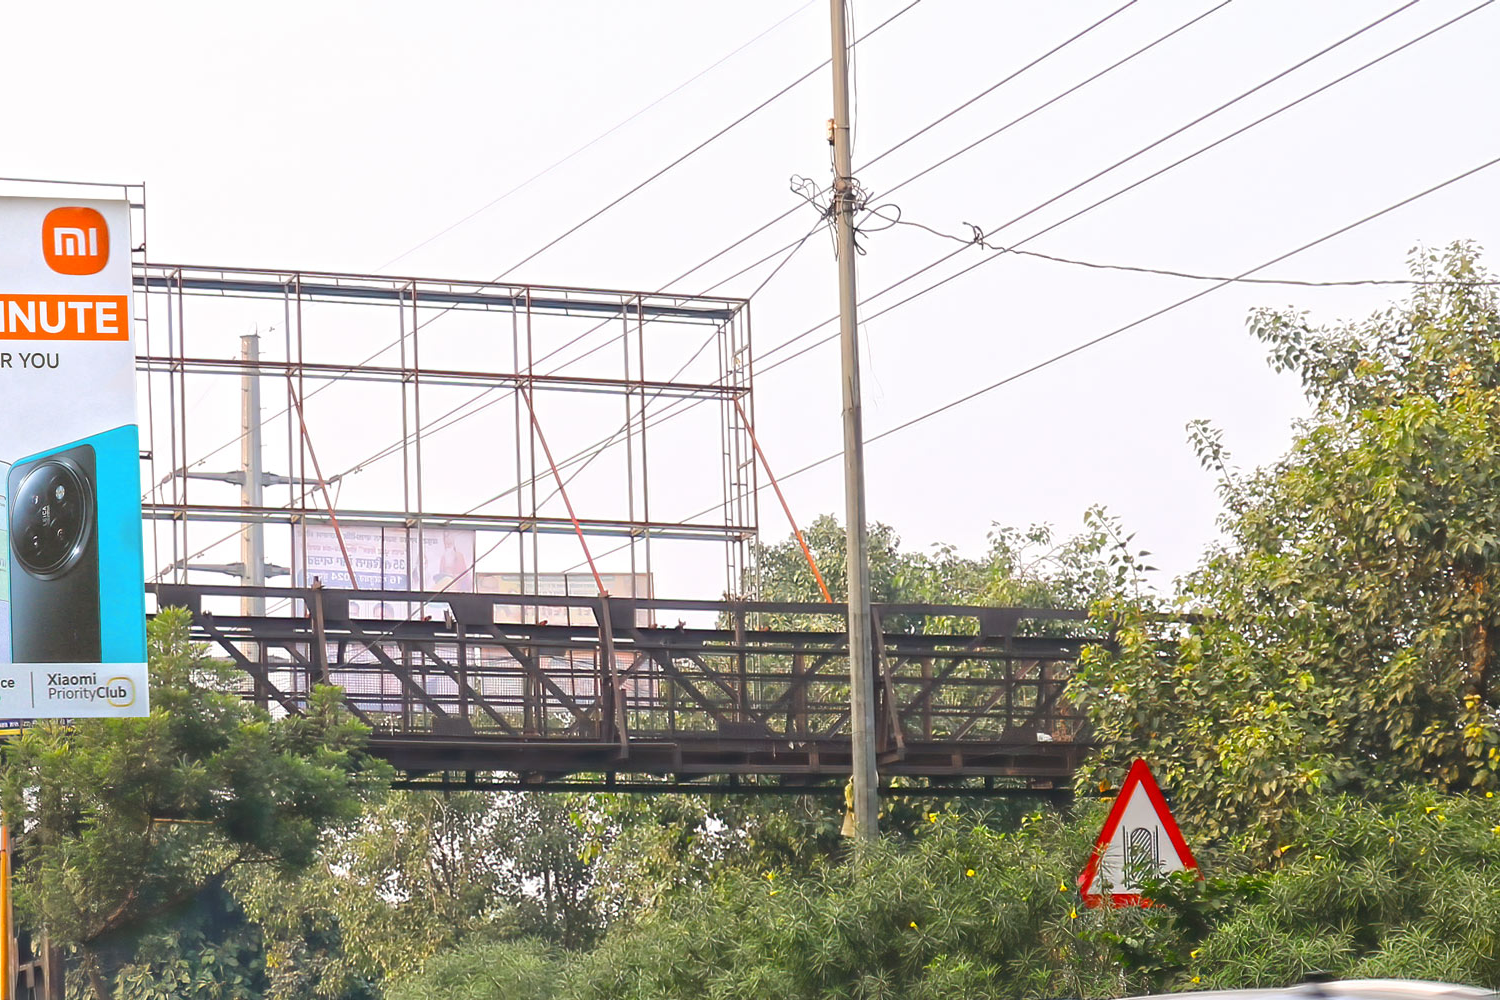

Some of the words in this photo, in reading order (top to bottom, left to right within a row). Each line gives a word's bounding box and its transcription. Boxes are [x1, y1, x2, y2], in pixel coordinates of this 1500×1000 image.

[18, 352, 60, 369] YOU
[47, 673, 97, 686] Xiaomi
[48, 686, 127, 702] PriorityClub
